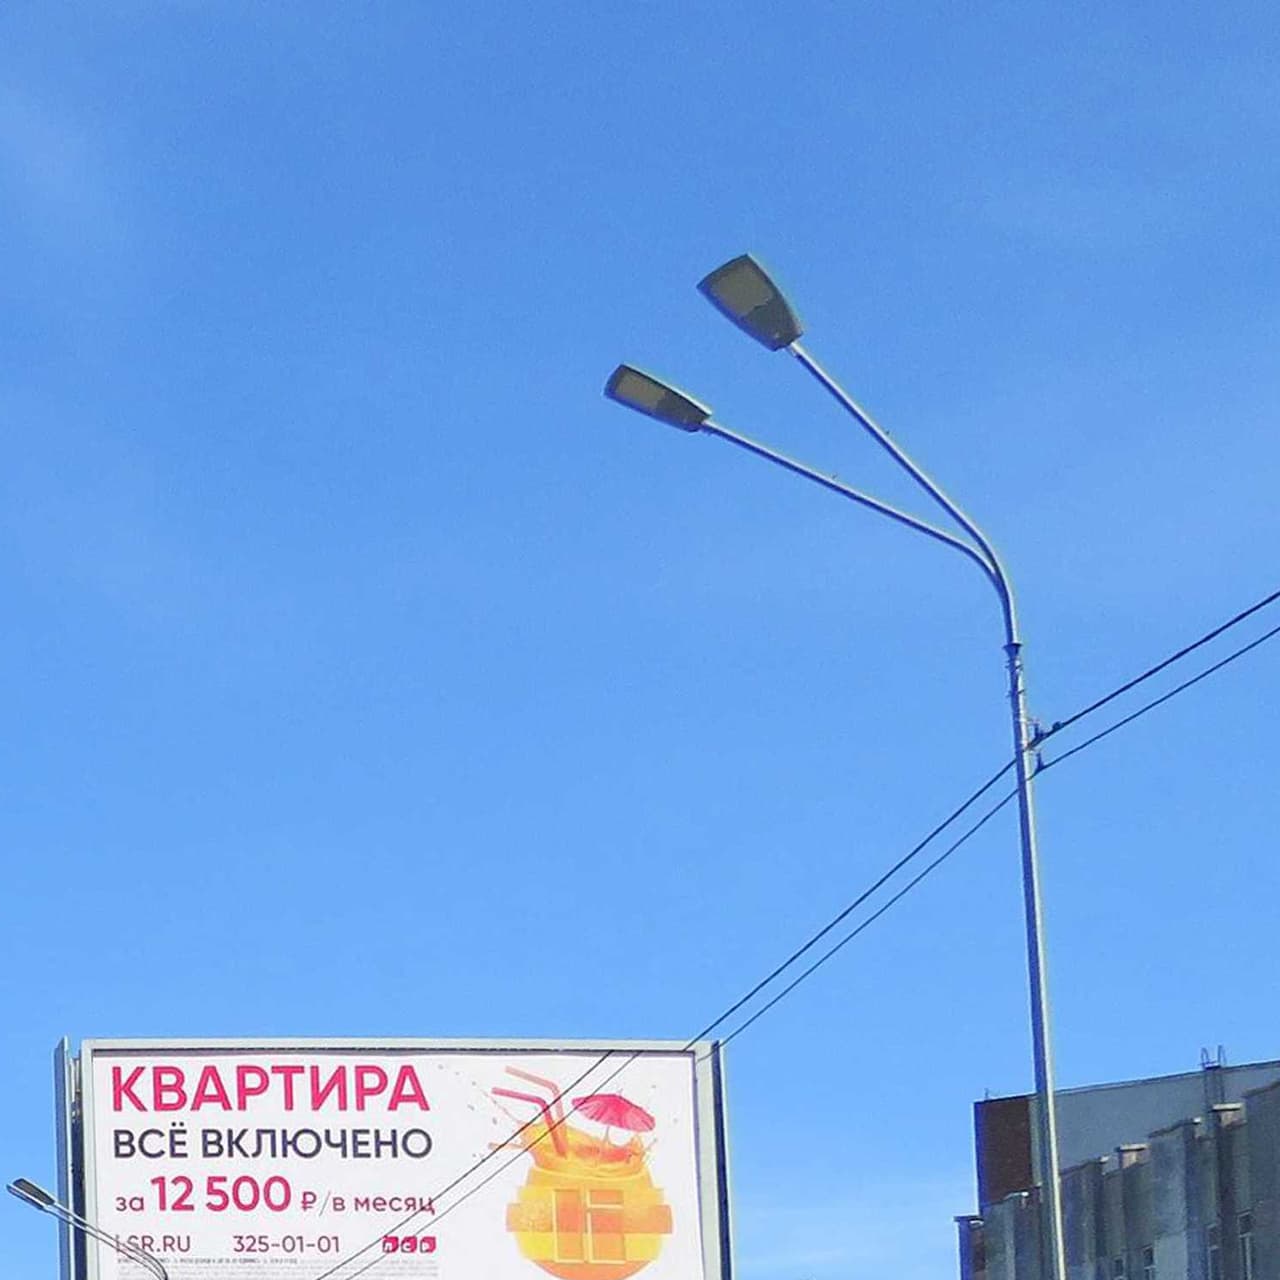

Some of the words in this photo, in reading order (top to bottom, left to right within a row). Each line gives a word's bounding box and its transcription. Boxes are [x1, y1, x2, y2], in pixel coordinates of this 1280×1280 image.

[112, 1065, 431, 1112] КВАРТИРА
[113, 1122, 189, 1159] ВСЁ
[201, 1128, 433, 1159] ВКЛЮЧЕНО
[115, 1196, 145, 1212] за
[150, 1175, 195, 1213] 12
[205, 1175, 292, 1213] 500
[354, 1196, 436, 1215] месяц
[232, 1235, 340, 1253] 325-01-01
